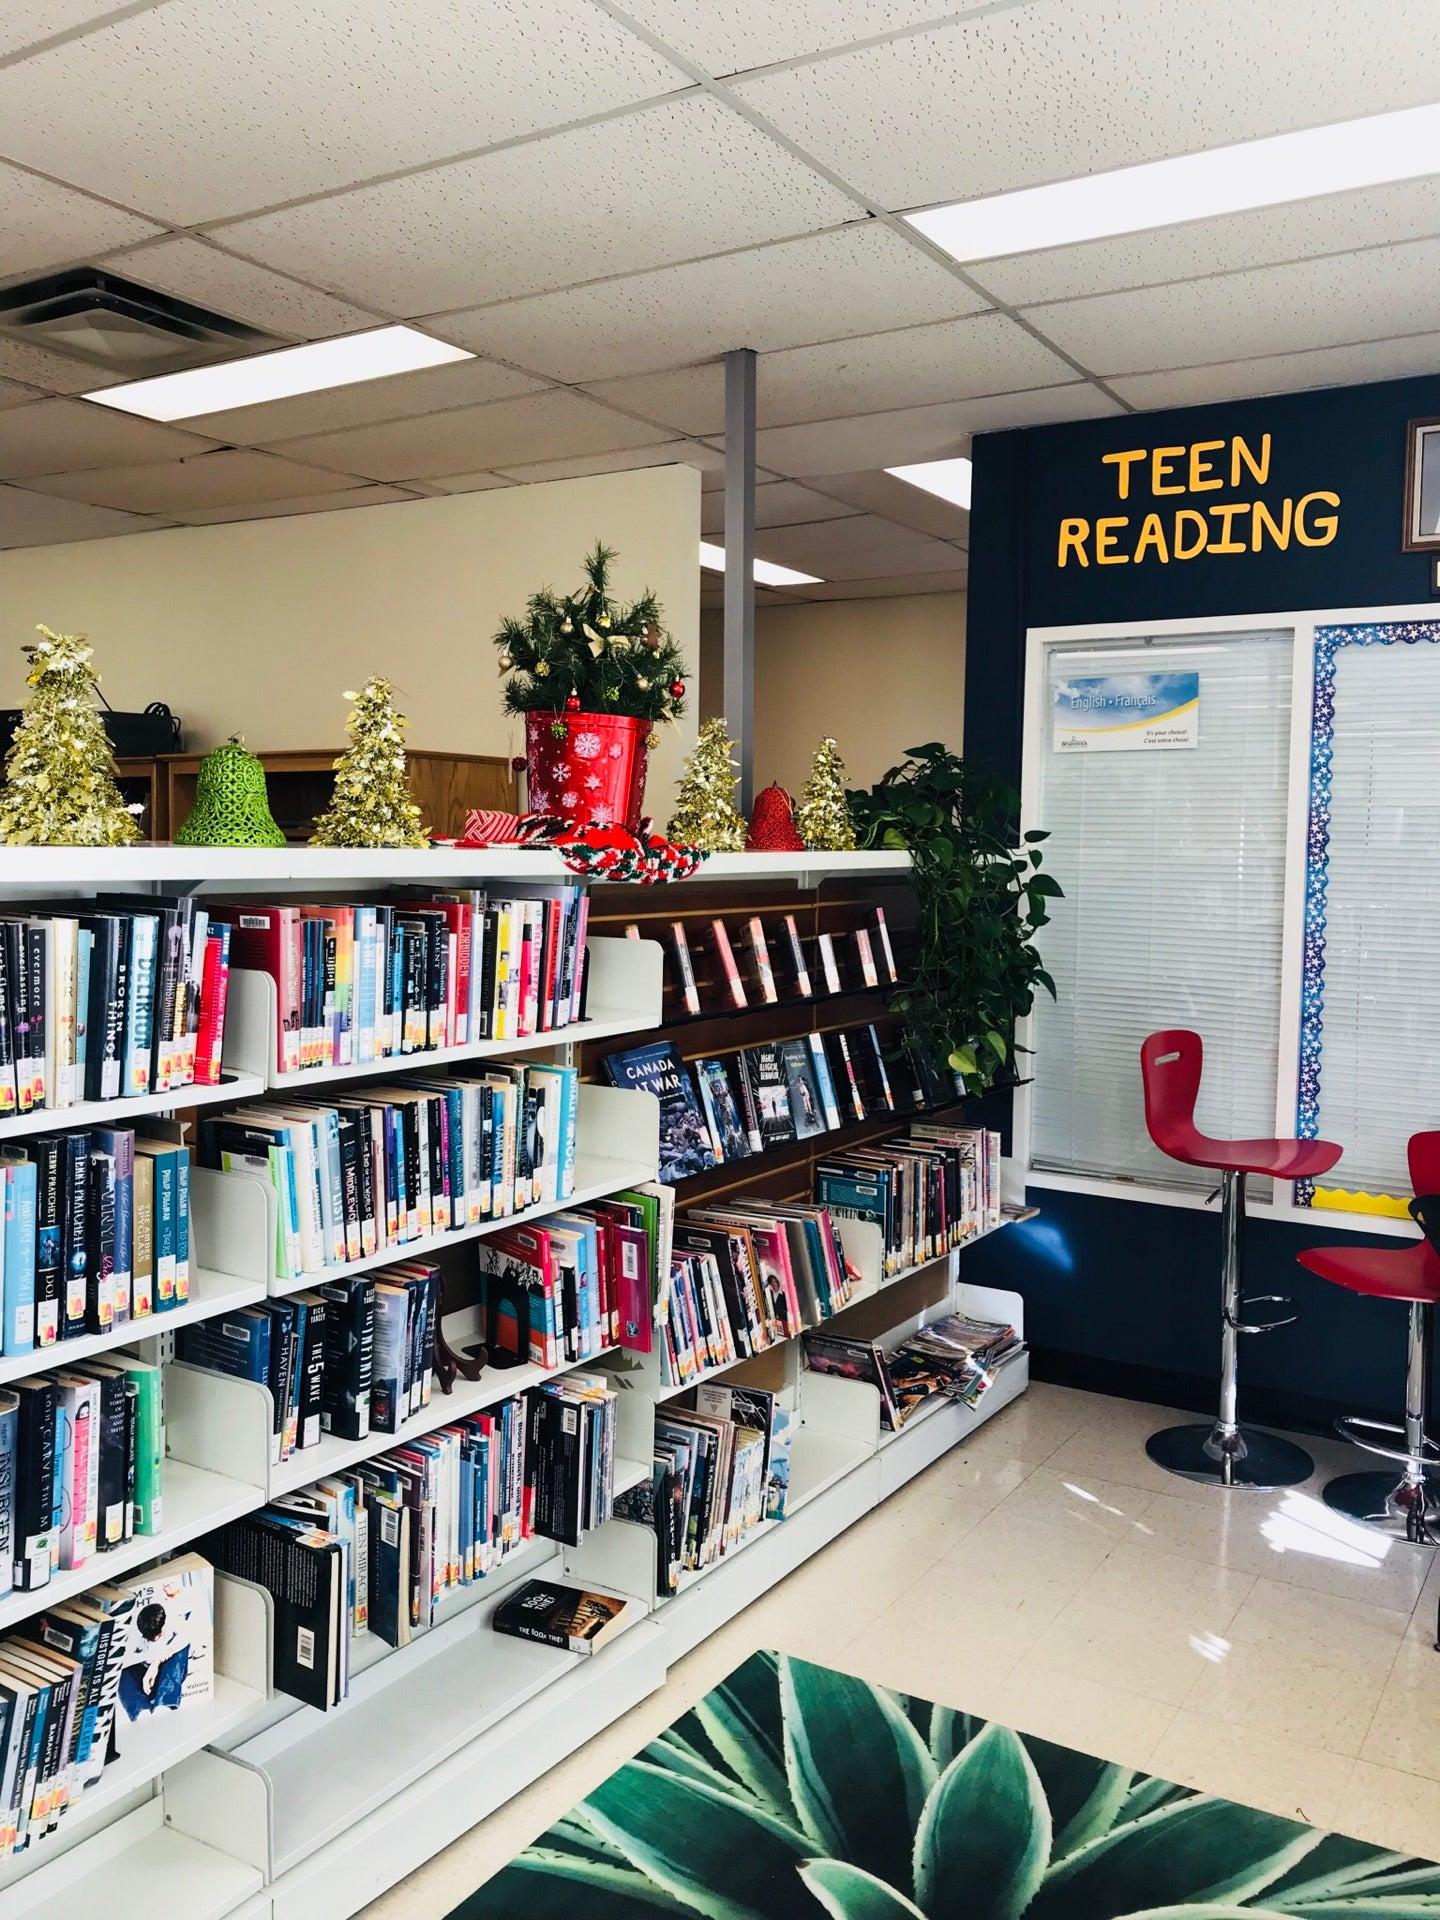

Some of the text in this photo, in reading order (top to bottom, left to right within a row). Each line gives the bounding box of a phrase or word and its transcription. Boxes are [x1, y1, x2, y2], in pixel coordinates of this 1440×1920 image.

[1102, 433, 1271, 499] TEEN
[1057, 491, 1341, 568] READING
[1071, 694, 1156, 711] English Français
[460, 927, 470, 977] FORBIDDEN
[17, 946, 28, 1013] everlasting
[116, 965, 126, 1032] BROKEN
[101, 1001, 117, 1061] THINGS
[839, 1034, 850, 1061] MANGA
[626, 1058, 676, 1080] CANADA
[651, 1074, 682, 1094] WAR
[565, 1073, 577, 1169] WHALEY NOG
[495, 1123, 504, 1175] VARIANT
[47, 1150, 57, 1224] TERRY PRATCHETT
[162, 1170, 171, 1190] PHILIP
[178, 1166, 188, 1217] PHILIP PULLMAN
[73, 1154, 87, 1248] TERRY PRATCHETT
[162, 1192, 171, 1221] PULLMAN
[333, 1192, 343, 1221] LIST
[101, 1190, 115, 1252] VINYL
[311, 1314, 326, 1323] YANCEY
[313, 1306, 324, 1315] RICK
[278, 1347, 289, 1387] HAVEN
[308, 1342, 324, 1403] THE 5 WAVE
[359, 1327, 374, 1388] INFINIT
[515, 1421, 523, 1450] Blood,
[41, 1429, 50, 1482] CARVE
[79, 1445, 87, 1464] ALL
[0, 1450, 12, 1554] INSURGEN
[41, 1487, 49, 1509] THE
[358, 1516, 367, 1550] TEEN
[519, 1626, 530, 1635] THE
[531, 1628, 547, 1639] BOOK
[95, 1632, 110, 1671] HISTORY
[88, 1688, 98, 1705] ALL
[93, 1674, 102, 1684] IS
[186, 1680, 208, 1690] Valerie
[21, 1730, 30, 1758] HIDING
[44, 1724, 56, 1763] SARAH'S
[15, 1769, 24, 1792] PLAIN
